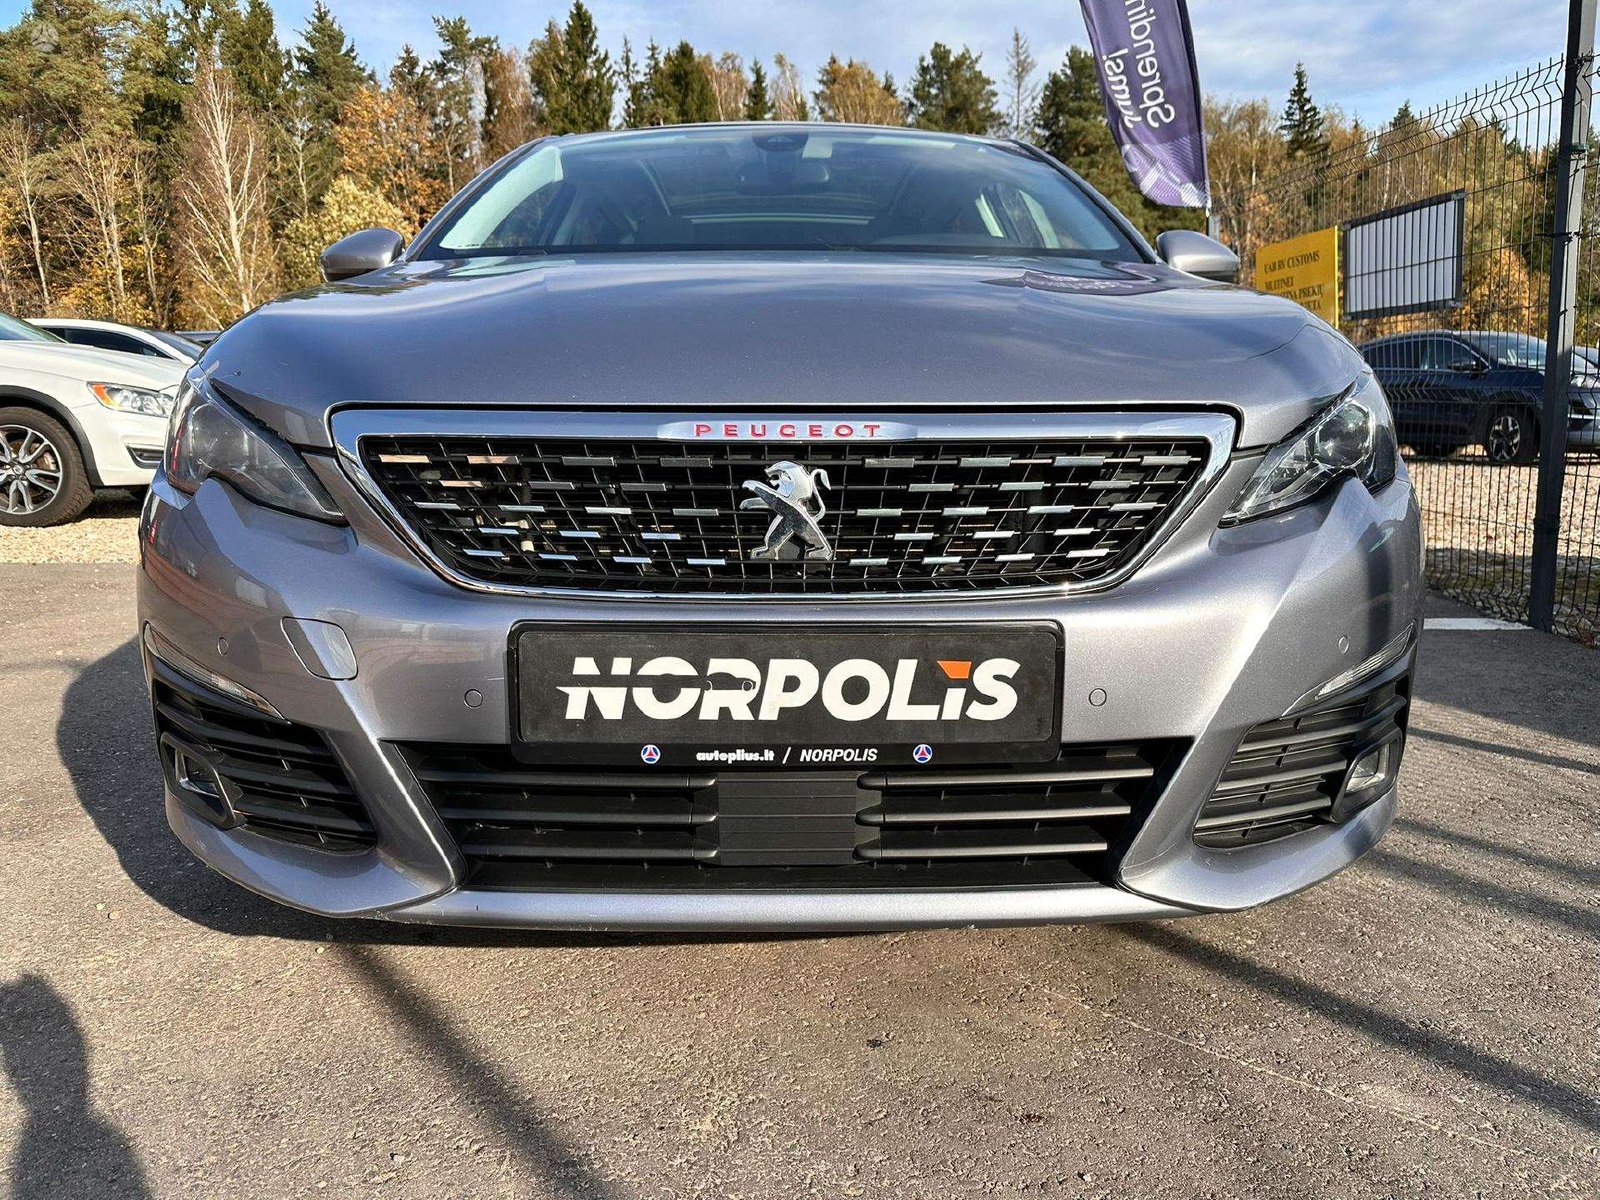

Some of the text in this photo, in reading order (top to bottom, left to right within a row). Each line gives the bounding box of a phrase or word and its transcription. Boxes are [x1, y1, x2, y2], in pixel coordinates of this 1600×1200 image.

[694, 424, 880, 438] PEUGEOT
[556, 656, 1021, 722] NORPOLIS
[696, 749, 775, 764] autoplius.lt
[799, 748, 878, 763] NORPOLIS
